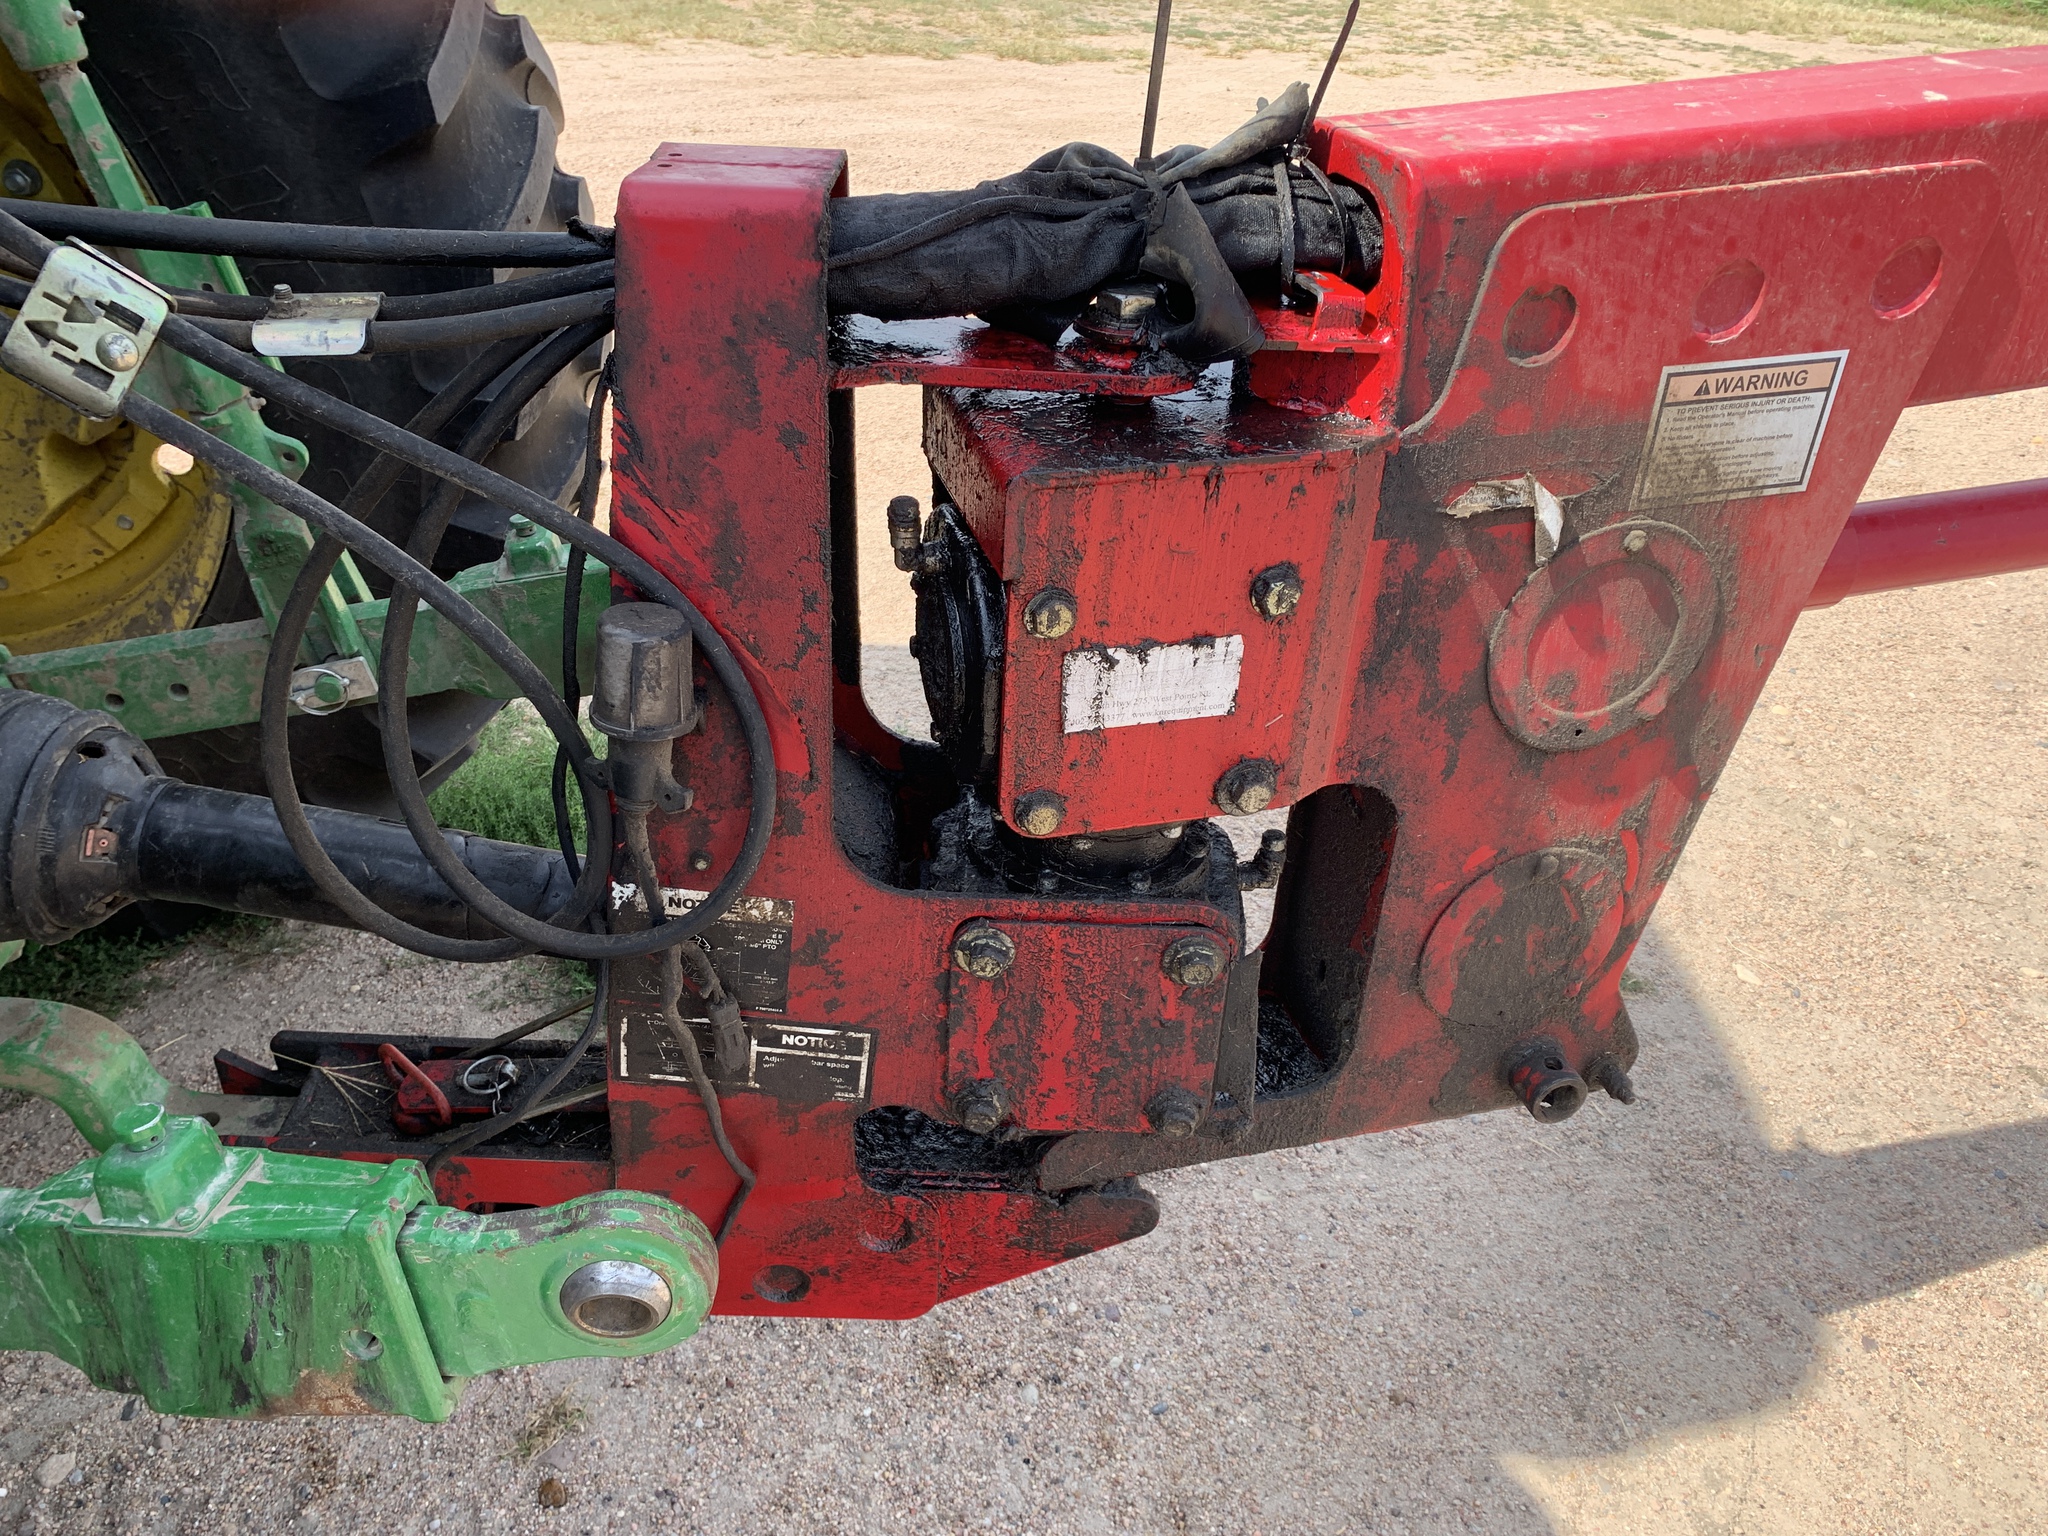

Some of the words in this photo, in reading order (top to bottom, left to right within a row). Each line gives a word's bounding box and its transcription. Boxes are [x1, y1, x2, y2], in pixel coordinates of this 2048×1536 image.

[1715, 369, 1808, 394] WARNING
[1687, 404, 1719, 415] PREVENT
[1719, 401, 1750, 411] SERIOUS
[1750, 398, 1776, 408] INJURY
[1776, 397, 1787, 405] OR
[1697, 412, 1726, 420] Operator's
[1765, 405, 1792, 414] operating
[1753, 434, 1776, 442] machine
[1151, 694, 1172, 704] West
[781, 1033, 847, 1051] NOTICE
[826, 1061, 850, 1069] space
